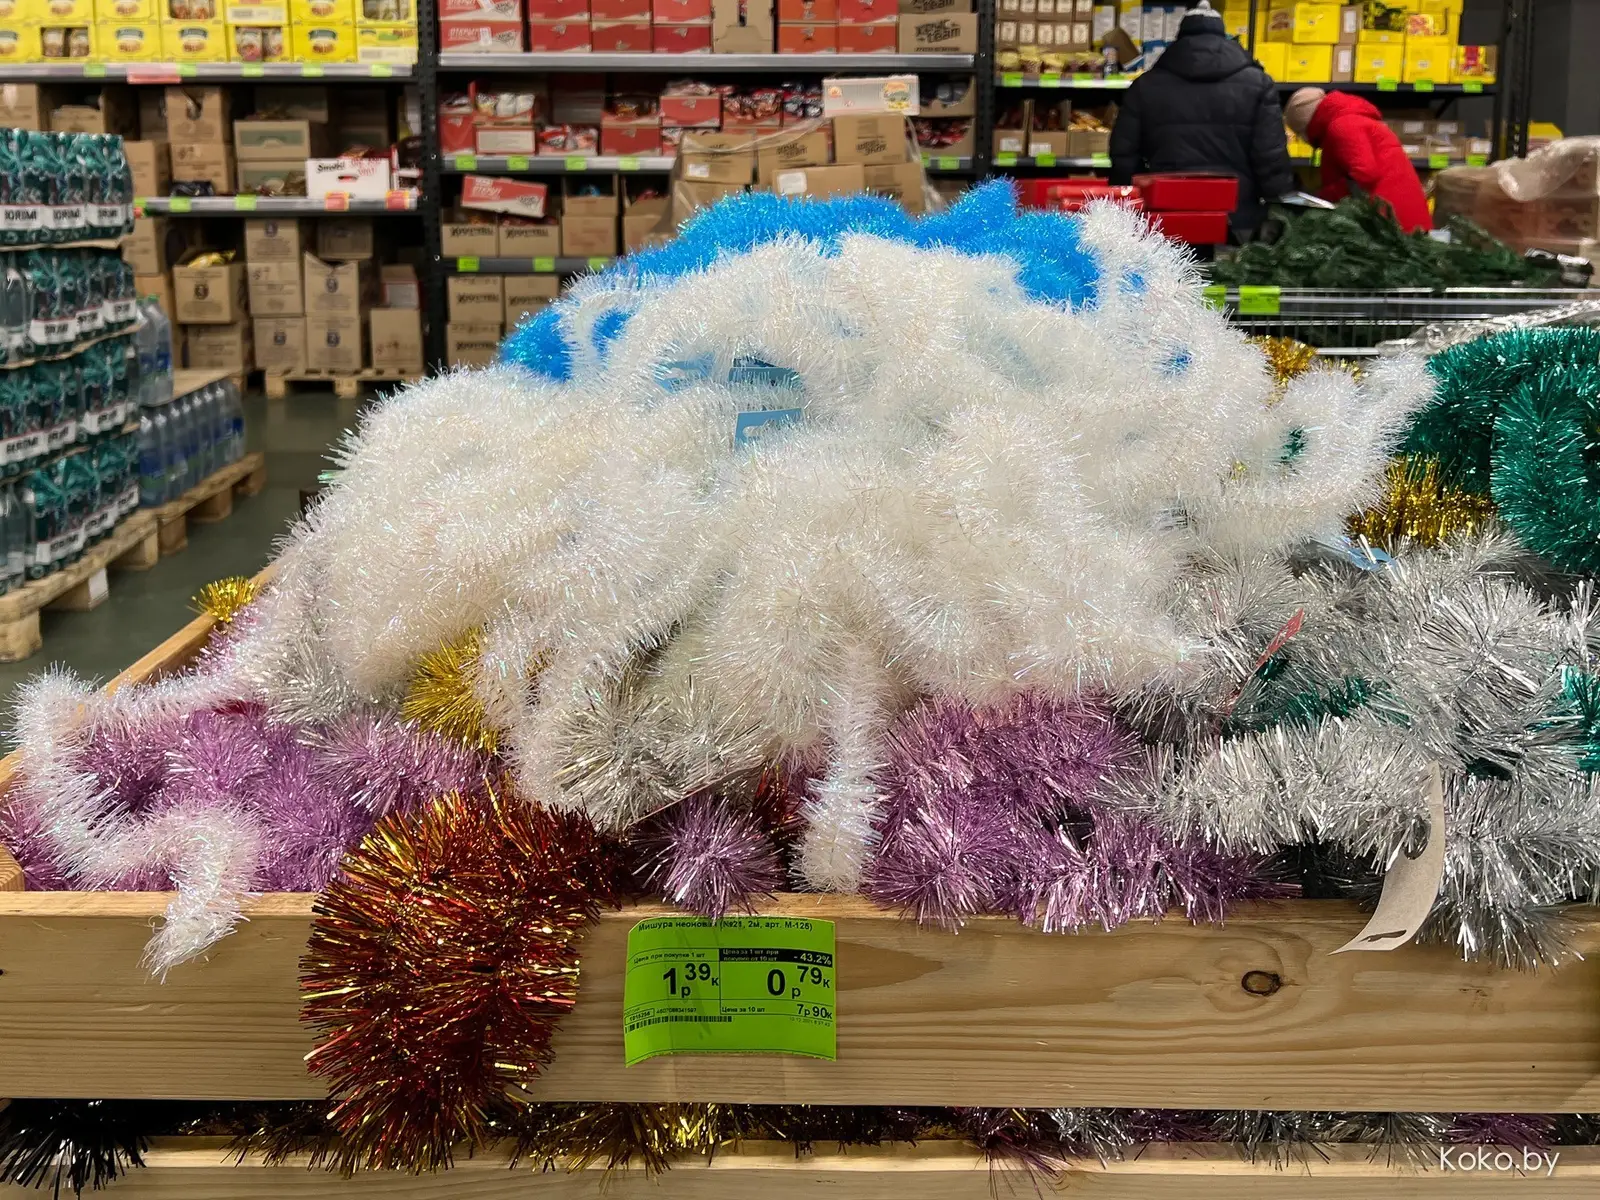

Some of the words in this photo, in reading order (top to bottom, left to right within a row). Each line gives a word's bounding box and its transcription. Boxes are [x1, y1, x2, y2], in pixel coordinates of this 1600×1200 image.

[638, 921, 673, 932] Мишура
[765, 922, 782, 930] арт.
[634, 955, 649, 964] Цена
[800, 952, 832, 966] 43.2%
[685, 962, 711, 981] 39
[797, 965, 823, 985] 79
